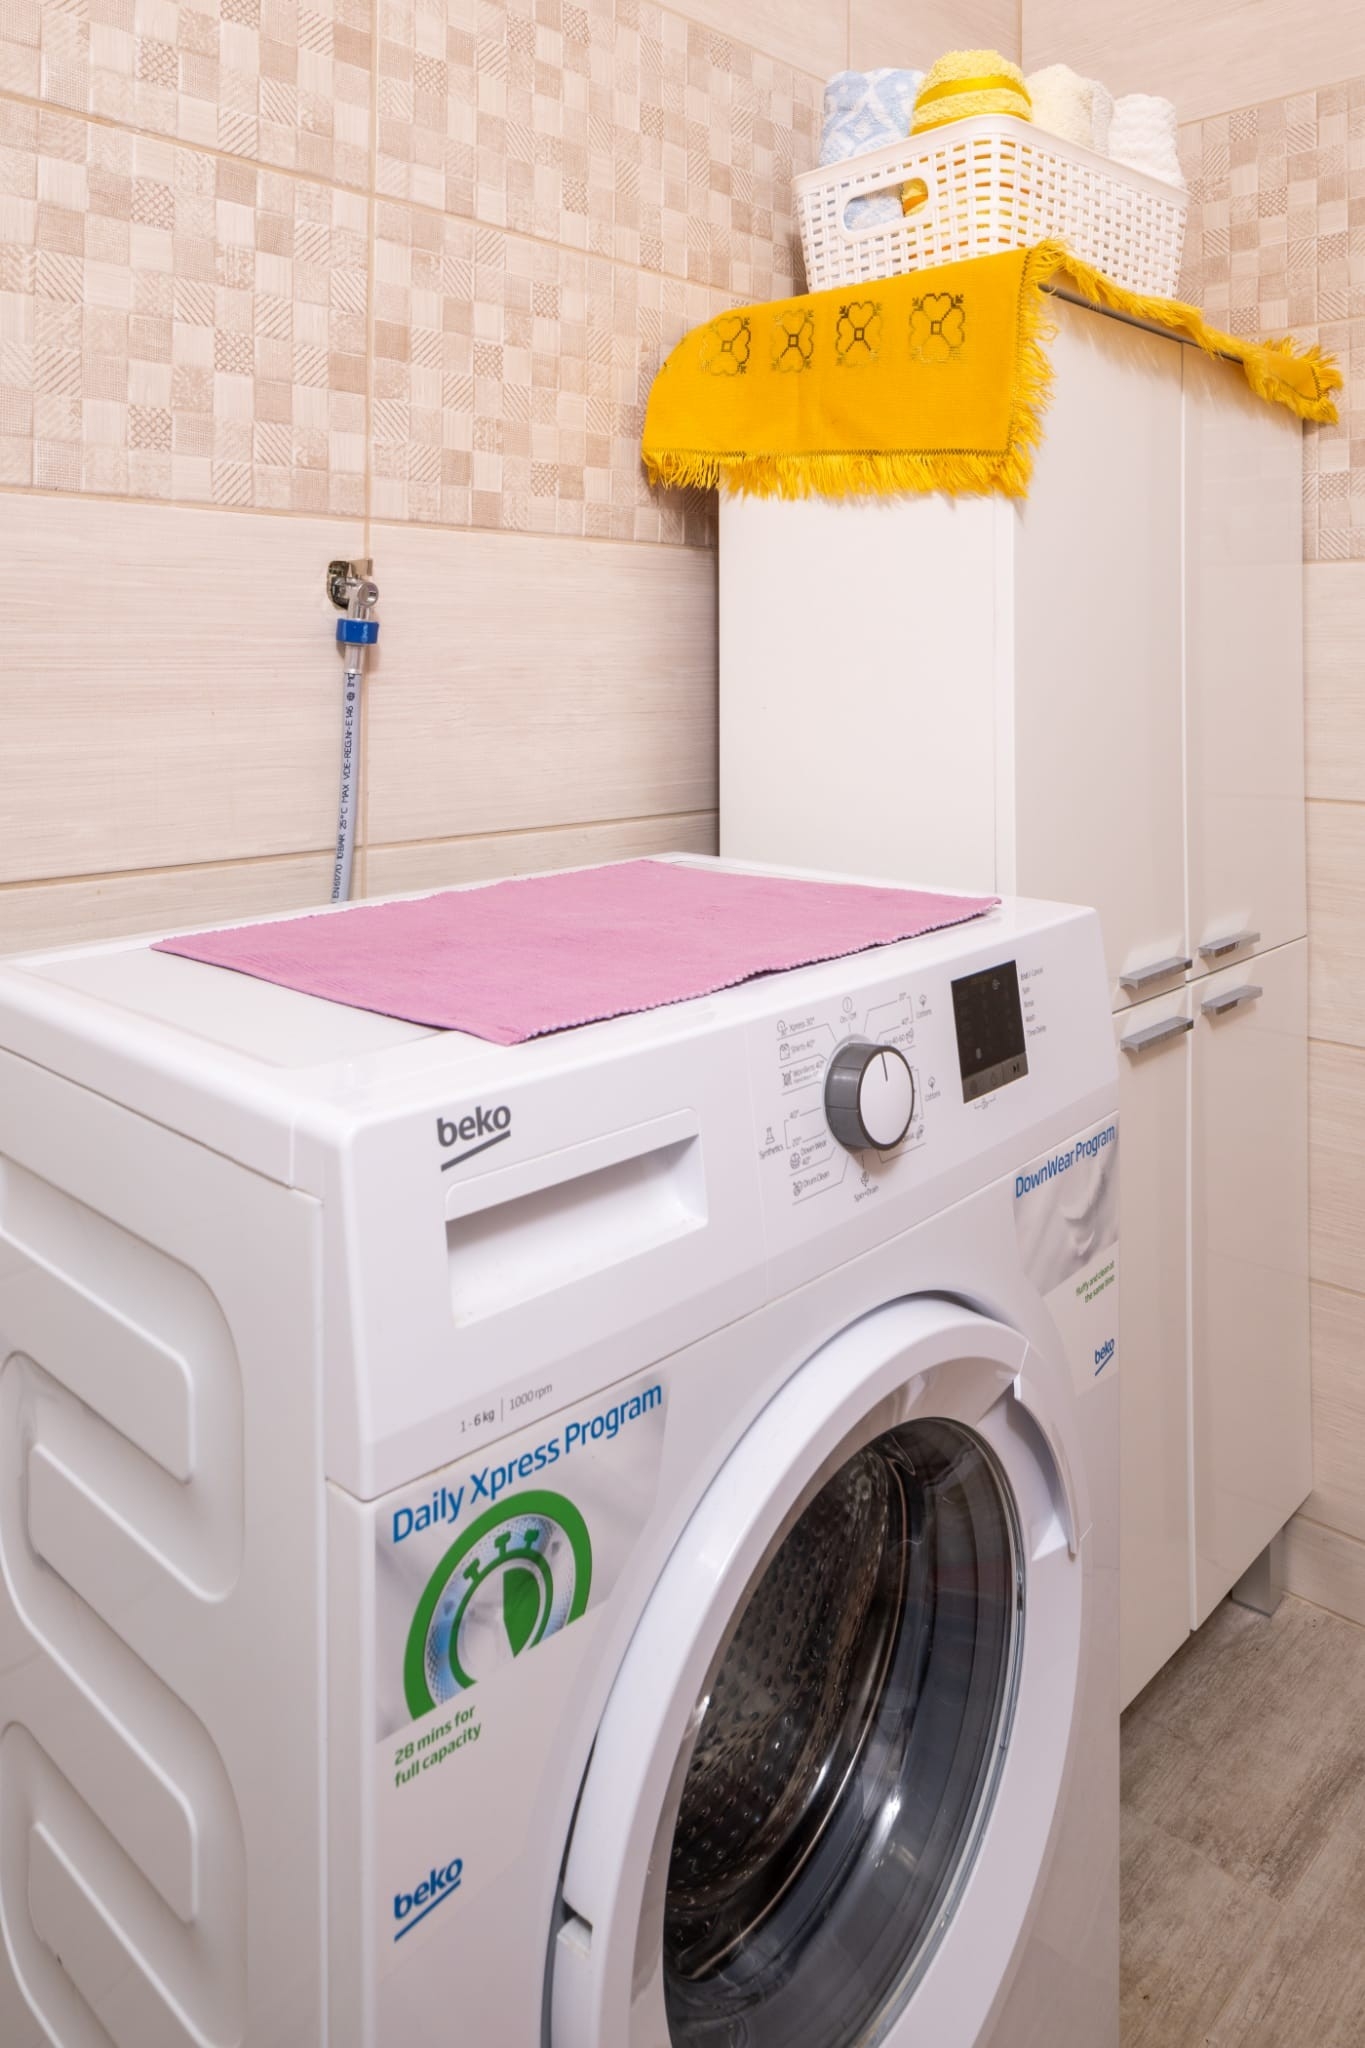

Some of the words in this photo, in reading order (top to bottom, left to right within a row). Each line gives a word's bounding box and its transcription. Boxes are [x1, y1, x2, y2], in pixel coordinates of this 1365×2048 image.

[341, 784, 350, 804] MAX
[437, 1105, 511, 1148] beko
[1015, 1150, 1075, 1199] DownWear
[1075, 1125, 1116, 1163] Program
[1094, 1338, 1115, 1365] beko
[482, 1409, 495, 1423] kg
[509, 1389, 534, 1411] 1000
[534, 1383, 552, 1401] rpm
[393, 1486, 465, 1544] Daily
[470, 1437, 560, 1504] Xpress
[565, 1384, 662, 1454] Program
[394, 1741, 415, 1767] 28
[417, 1720, 453, 1751] mins
[453, 1704, 476, 1729] for
[394, 1759, 420, 1788] full
[422, 1722, 481, 1770] capacity
[393, 1857, 463, 1920] beko
